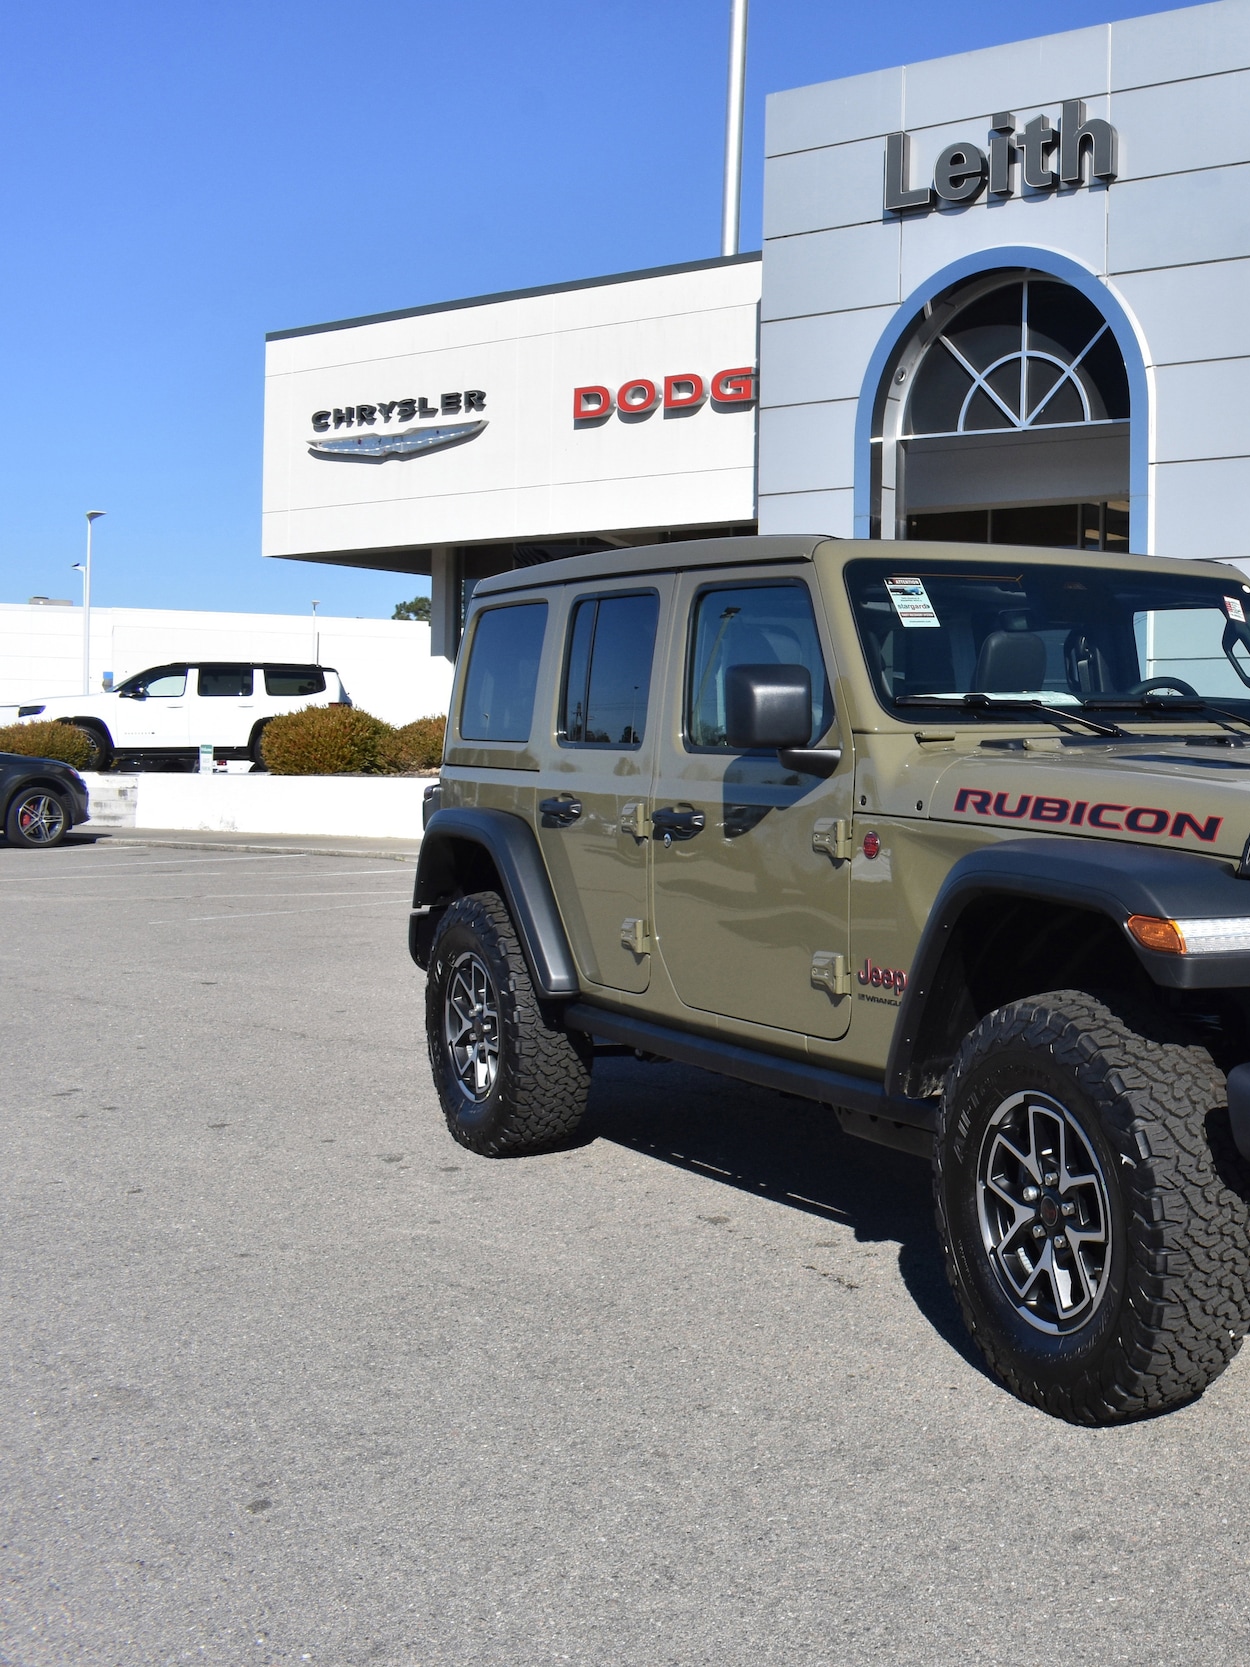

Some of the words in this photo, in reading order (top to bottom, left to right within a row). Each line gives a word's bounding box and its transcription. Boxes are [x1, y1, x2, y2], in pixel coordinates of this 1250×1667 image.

[884, 99, 1118, 213] Leith
[311, 389, 487, 430] CHRYSLER
[953, 787, 1224, 843] RUBICON
[858, 957, 908, 997] Jeep
[865, 994, 902, 1007] WRANGL
